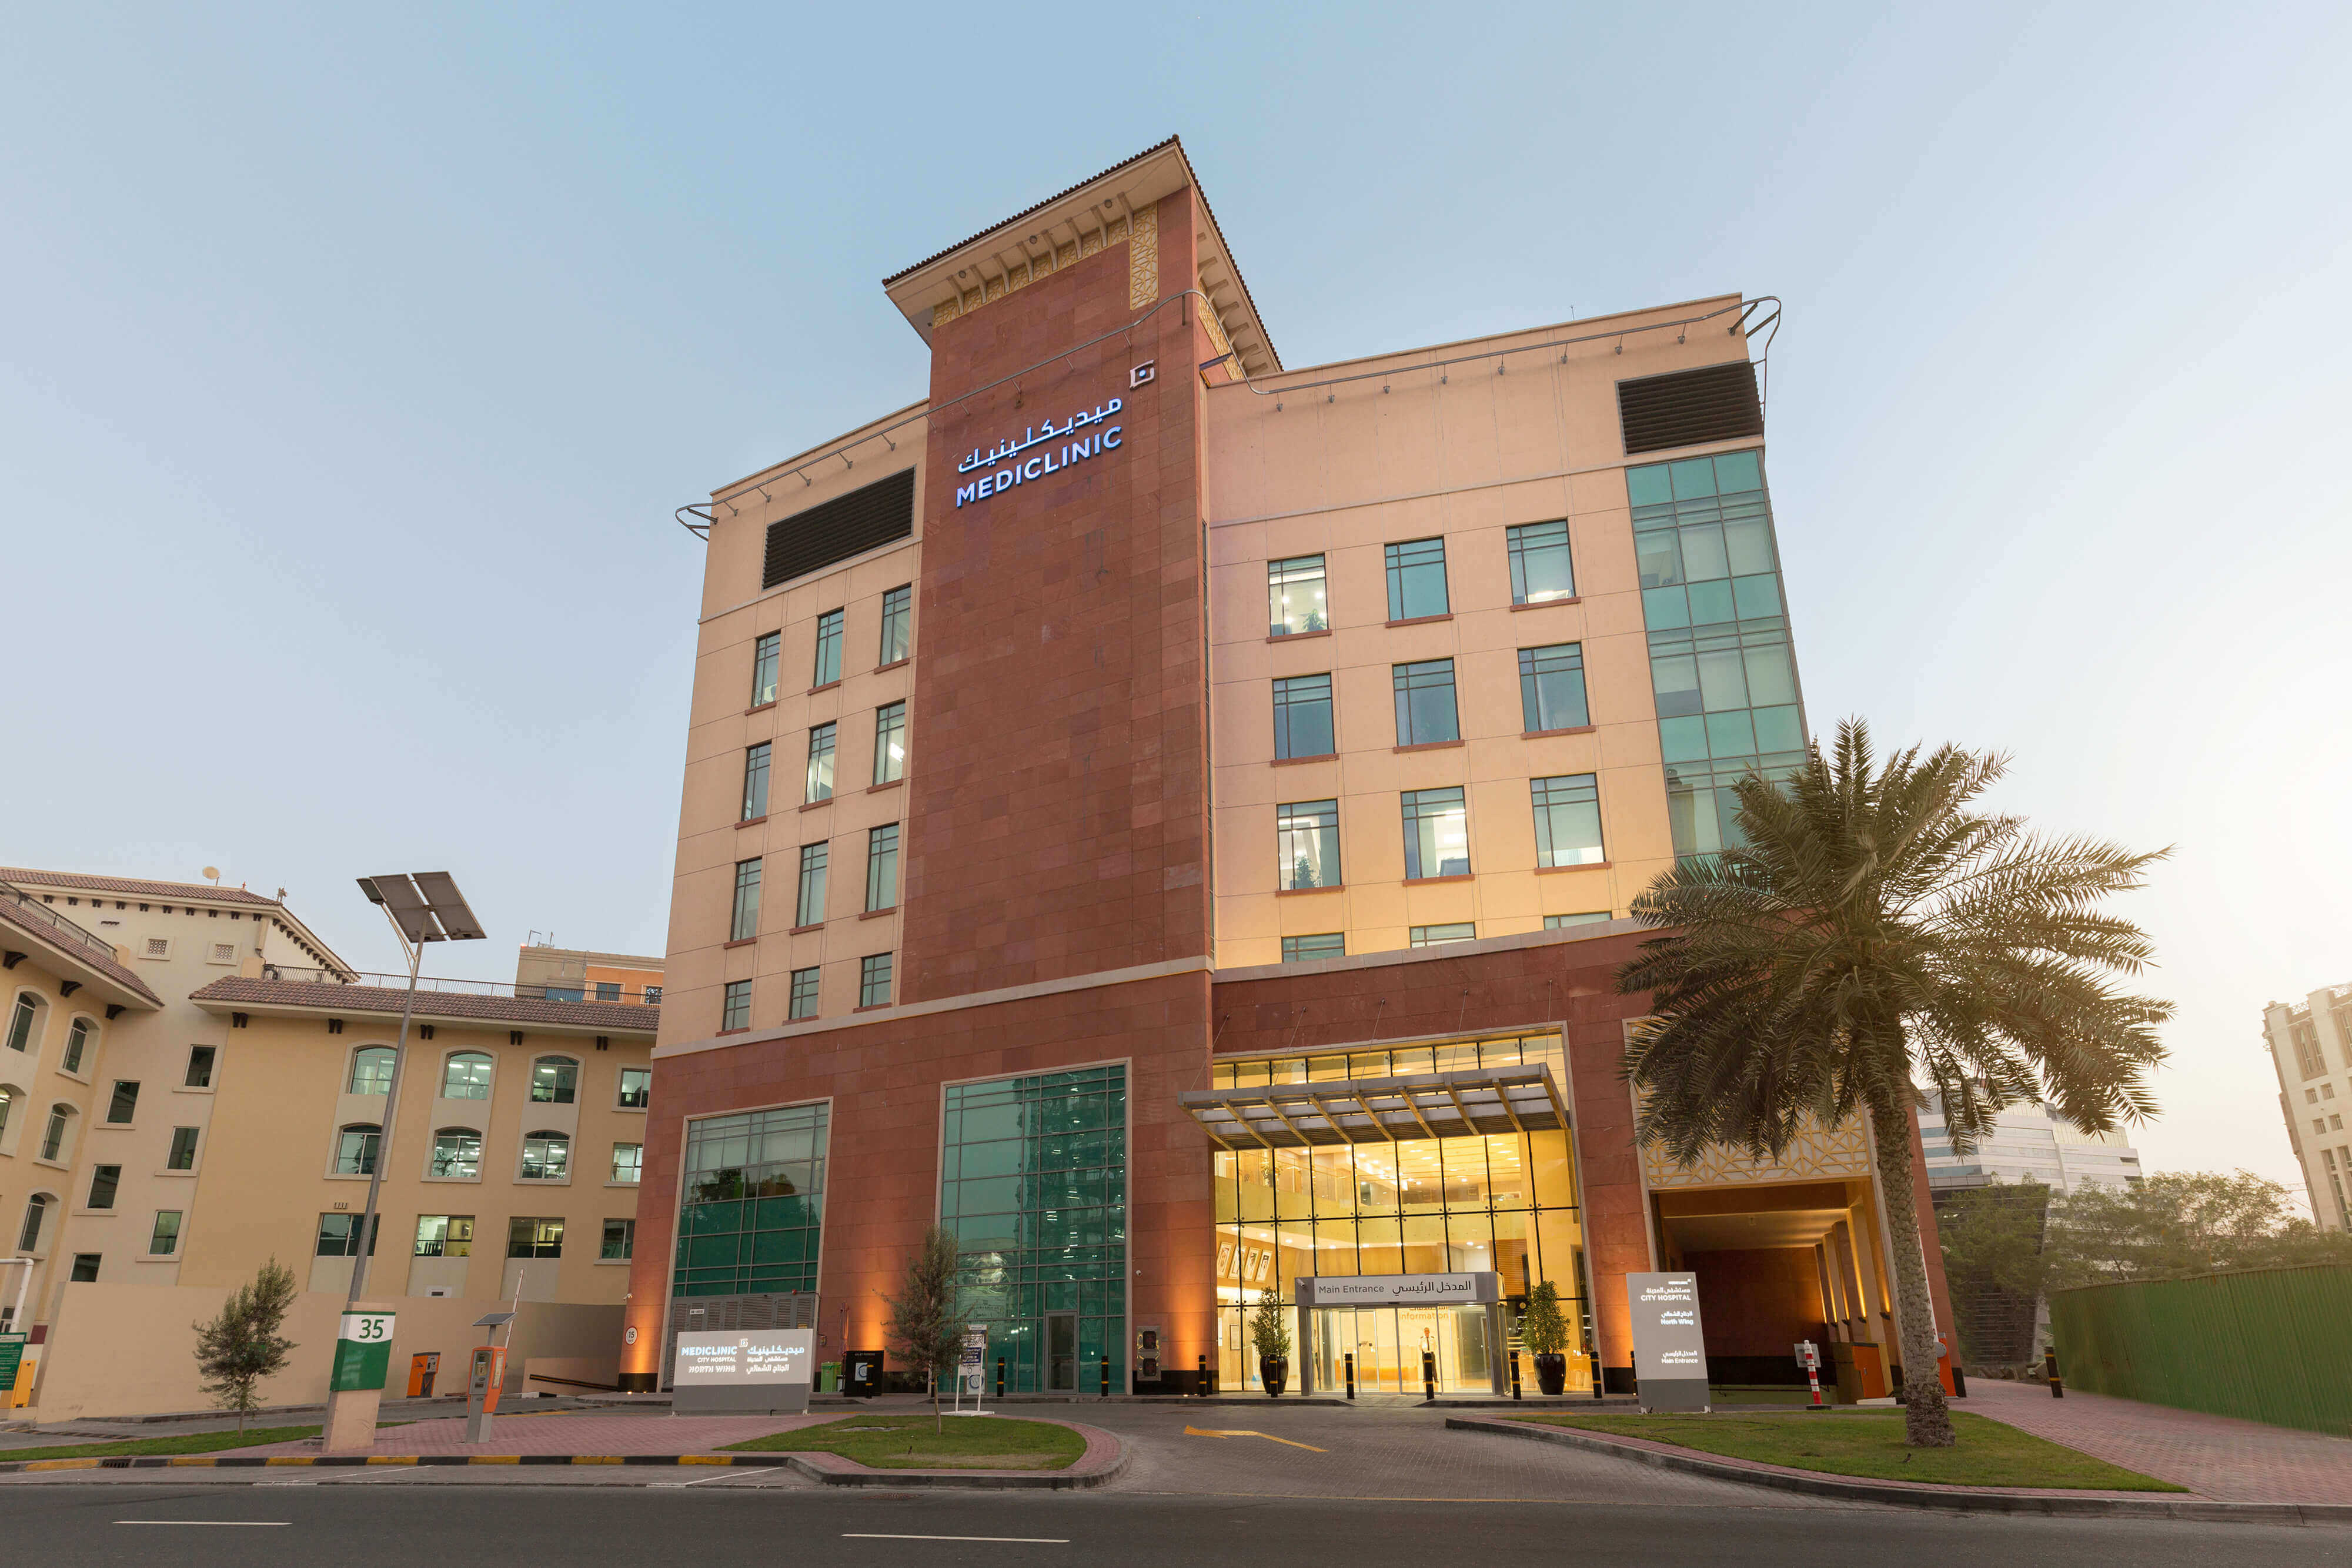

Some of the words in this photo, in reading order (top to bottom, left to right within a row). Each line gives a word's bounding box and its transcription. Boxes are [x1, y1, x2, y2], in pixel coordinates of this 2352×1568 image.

[958, 397, 1122, 474] ميديكلينيك
[957, 426, 1122, 508] MEDICLINIC
[1319, 1285, 1340, 1295] Main
[1343, 1285, 1384, 1293] Entrance
[1392, 1282, 1434, 1296] الرئيسي
[1436, 1281, 1471, 1293] المدخل
[1399, 1311, 1449, 1320] Informaton
[358, 1319, 384, 1339] 35
[681, 1346, 737, 1356] MEDICLINIC
